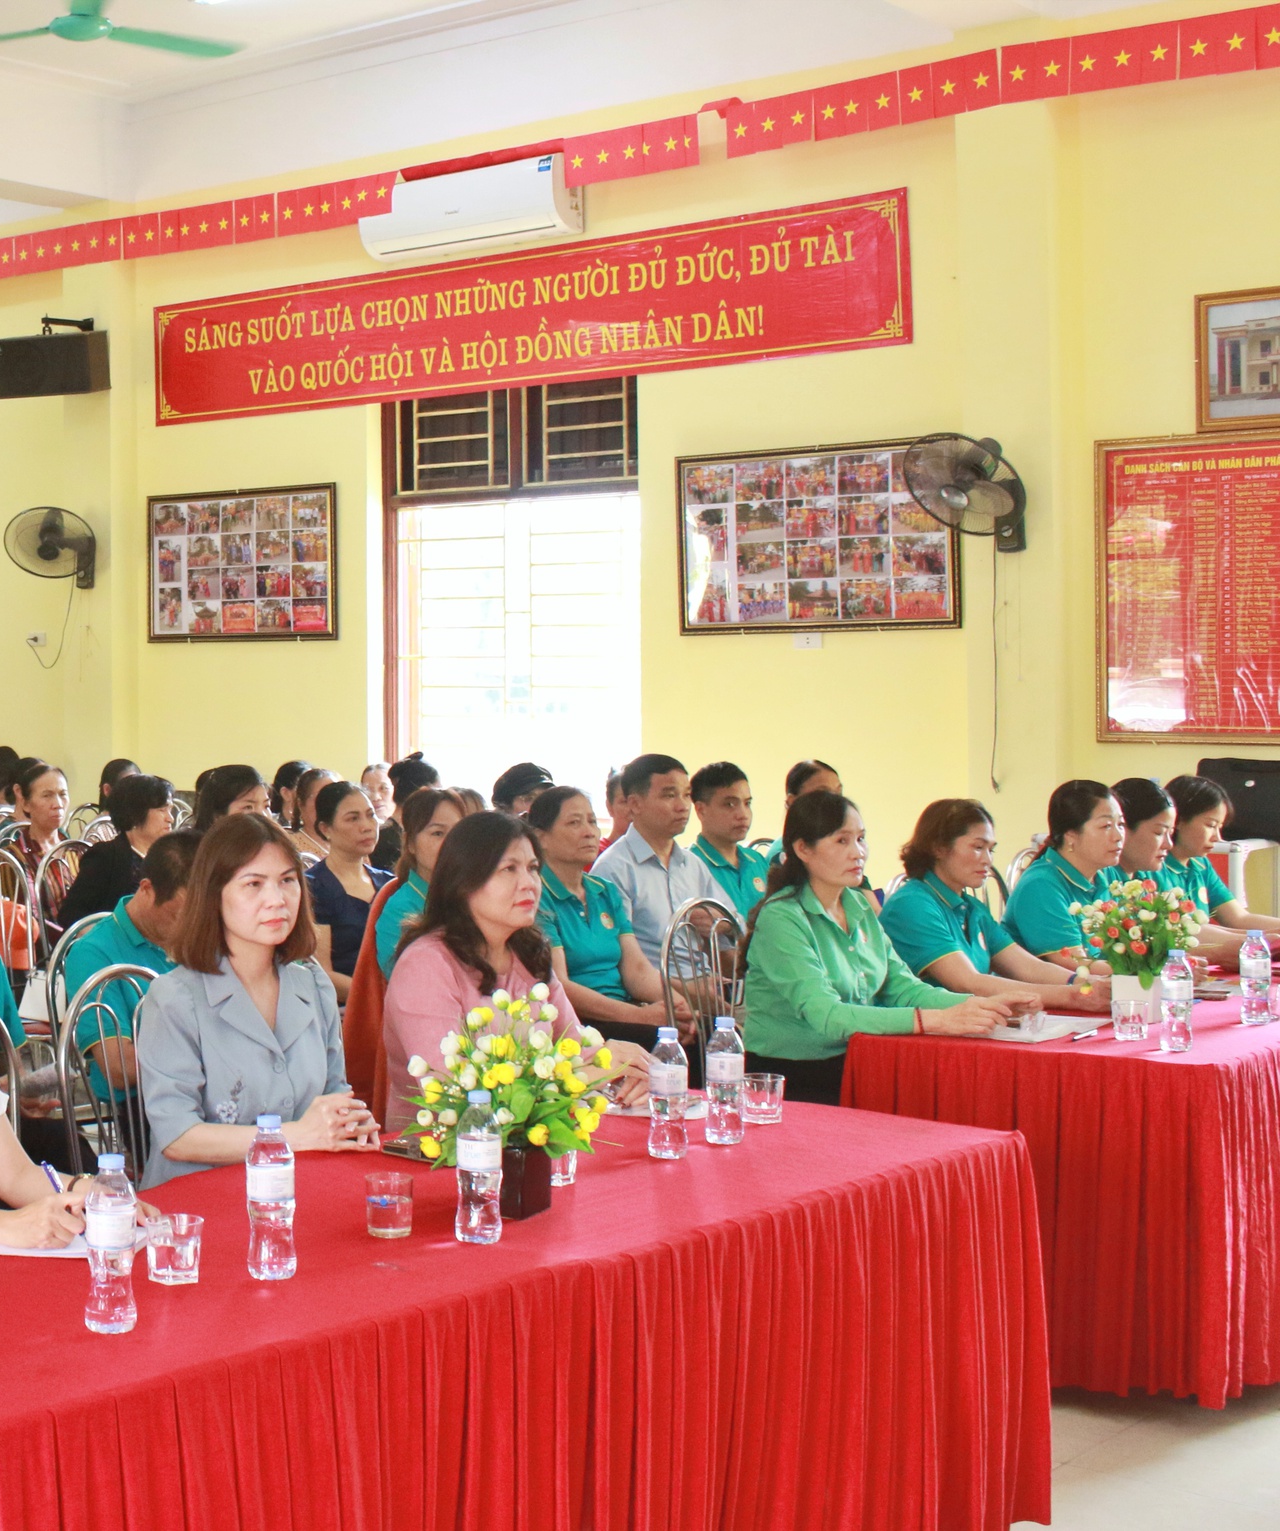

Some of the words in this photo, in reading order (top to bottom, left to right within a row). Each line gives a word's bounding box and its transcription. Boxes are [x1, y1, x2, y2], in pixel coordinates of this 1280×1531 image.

[184, 317, 243, 353] SÁNG
[247, 301, 305, 346] SUỐT
[310, 302, 356, 341] LỰA
[360, 294, 429, 332] CHỌN
[434, 277, 527, 319] NHỮNG
[532, 259, 620, 306] NGƯỜI
[628, 245, 668, 293] ĐỦ
[675, 242, 742, 286] ĐỨC,
[749, 226, 791, 276] ĐỦ
[799, 224, 856, 269] TÀI
[248, 359, 296, 395] VÀO
[299, 345, 365, 391] QUỐC
[369, 343, 414, 386] HỘI
[419, 337, 457, 376] VÀ
[461, 331, 509, 376] HỘI
[515, 317, 593, 364] ĐỒNG
[598, 309, 683, 354] NHÂN
[691, 300, 765, 344] DÂN!
[1124, 464, 1147, 475] DANH
[1149, 461, 1171, 473] SÁCH
[1192, 458, 1204, 473] BỘ
[1205, 457, 1217, 470] VÀ
[1218, 456, 1242, 469] NHÂN
[1244, 455, 1263, 468] DÂN
